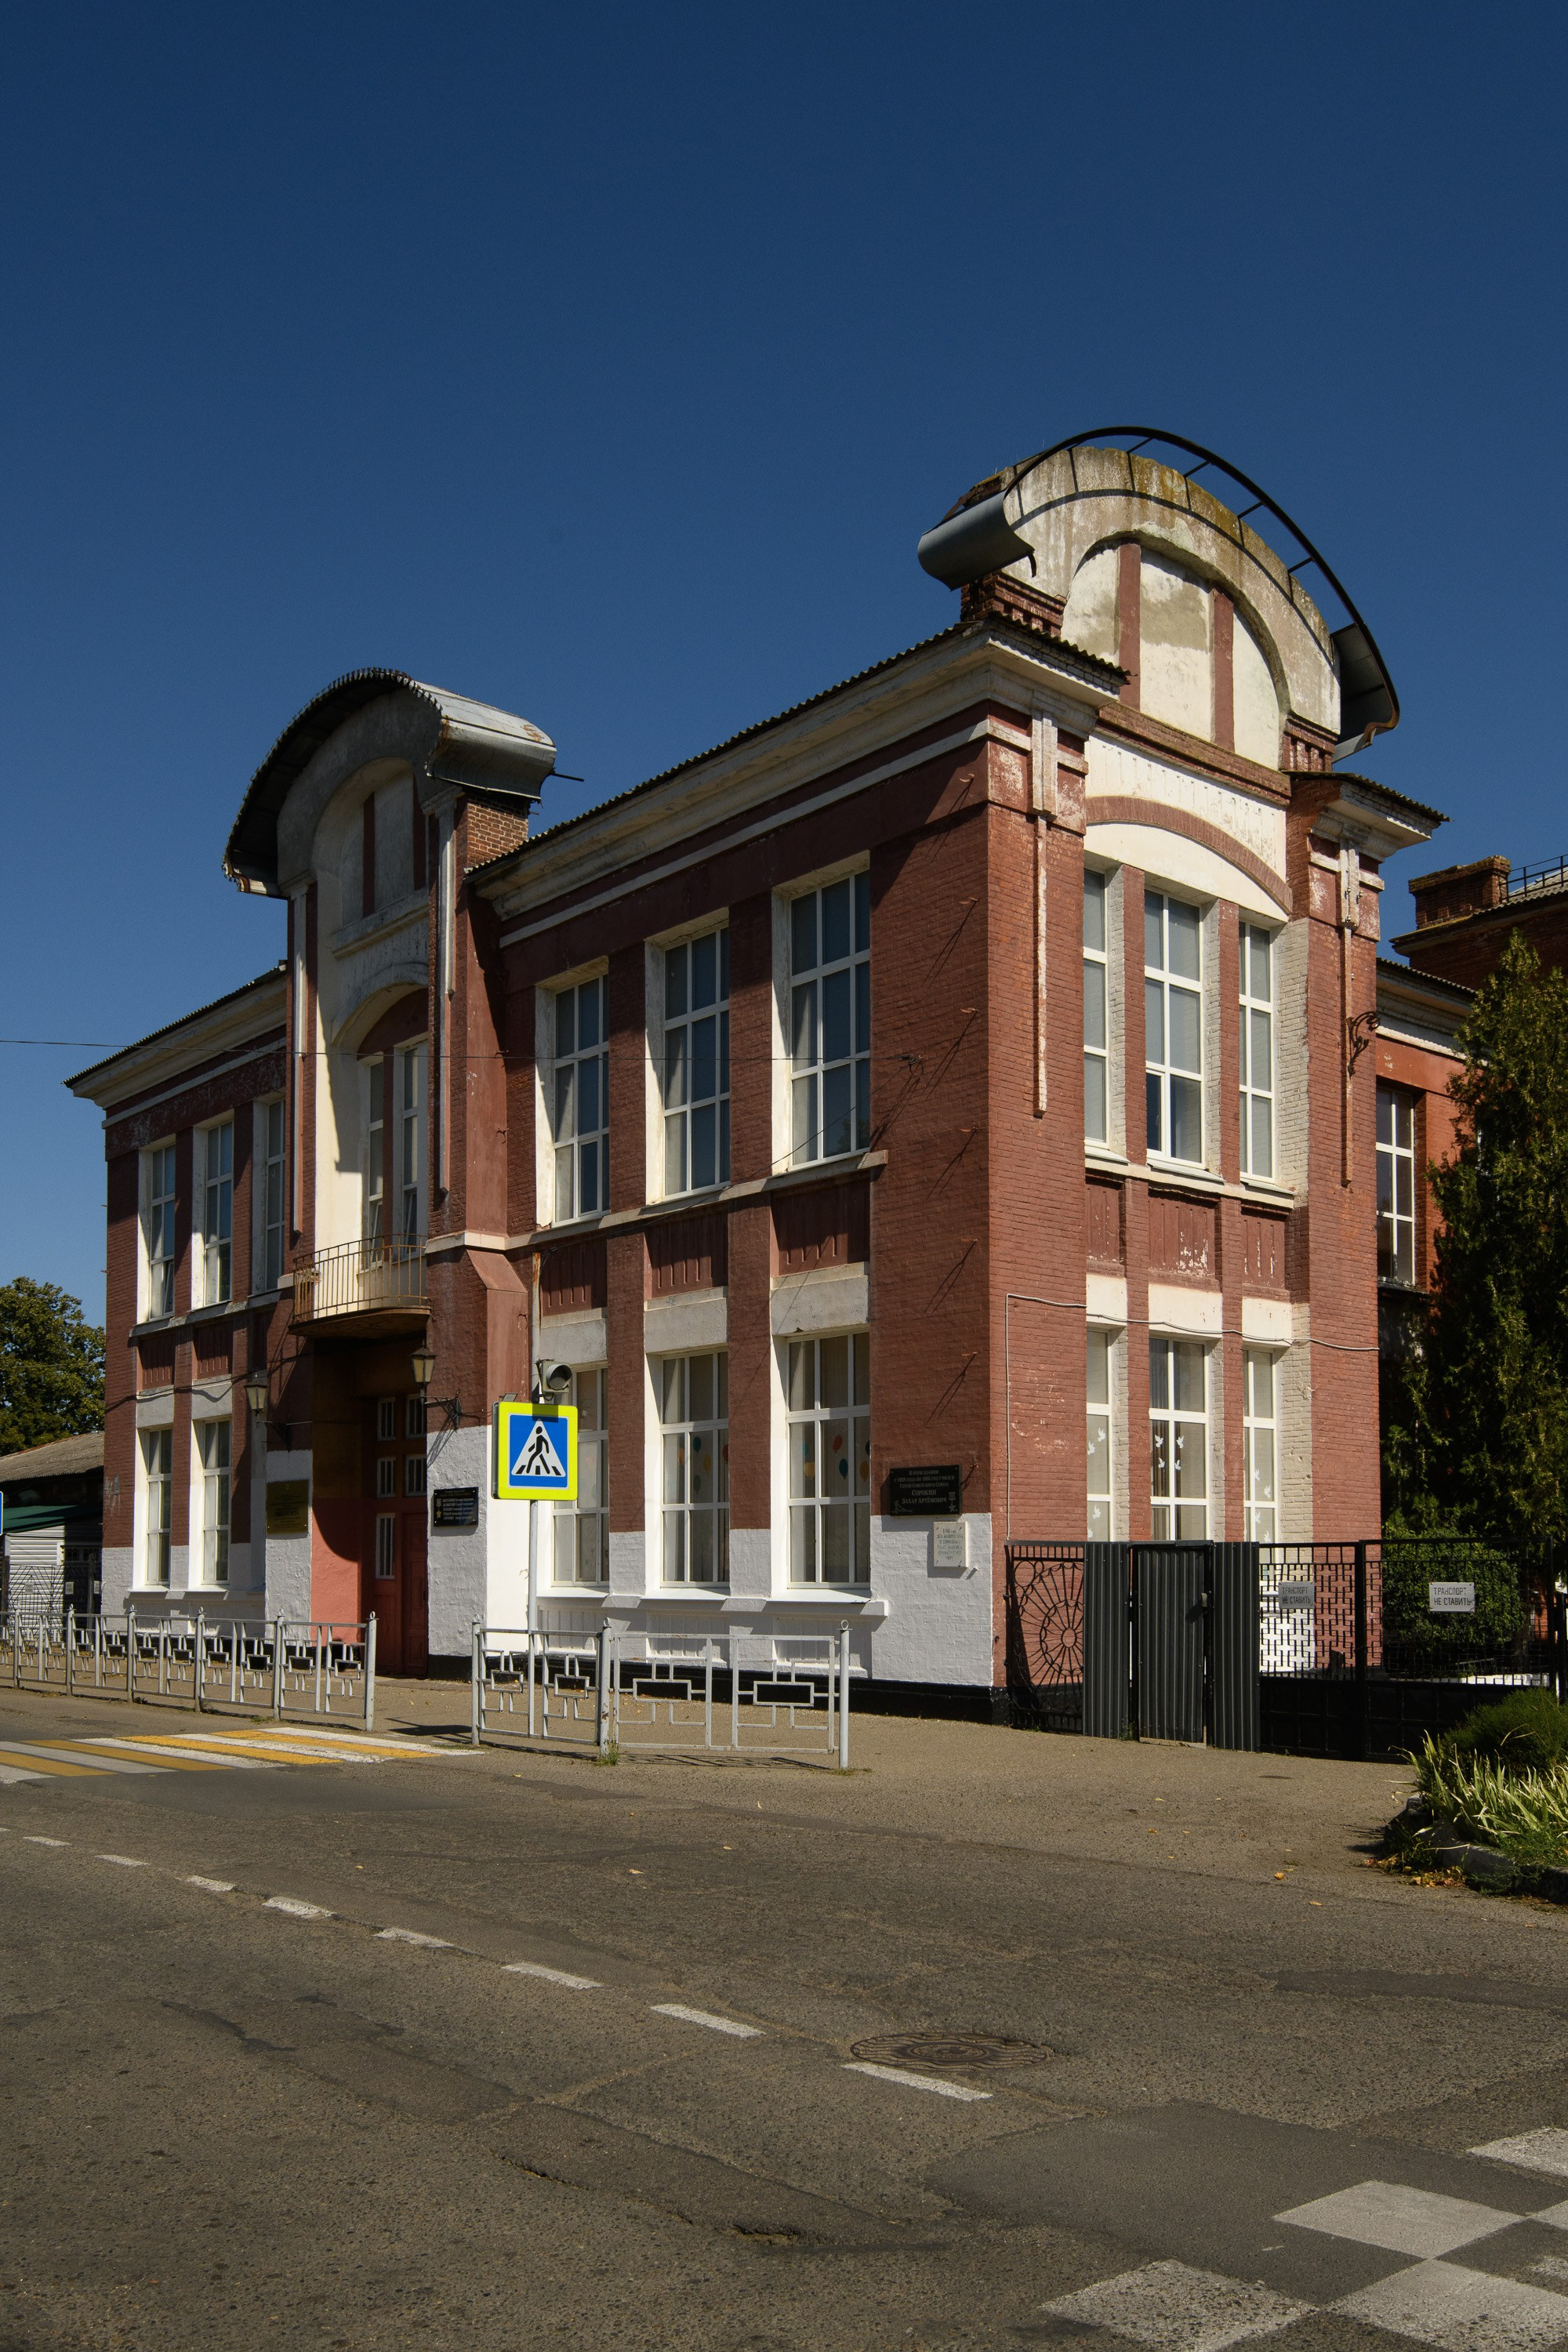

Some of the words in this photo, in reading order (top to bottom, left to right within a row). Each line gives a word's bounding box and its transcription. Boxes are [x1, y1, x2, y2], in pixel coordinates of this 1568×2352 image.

[1282, 1586, 1308, 1595] ТРАНСПОРТ
[1433, 1587, 1467, 1595] ТРАНСПОРТ
[1290, 1595, 1312, 1604] СТАВИТЬ
